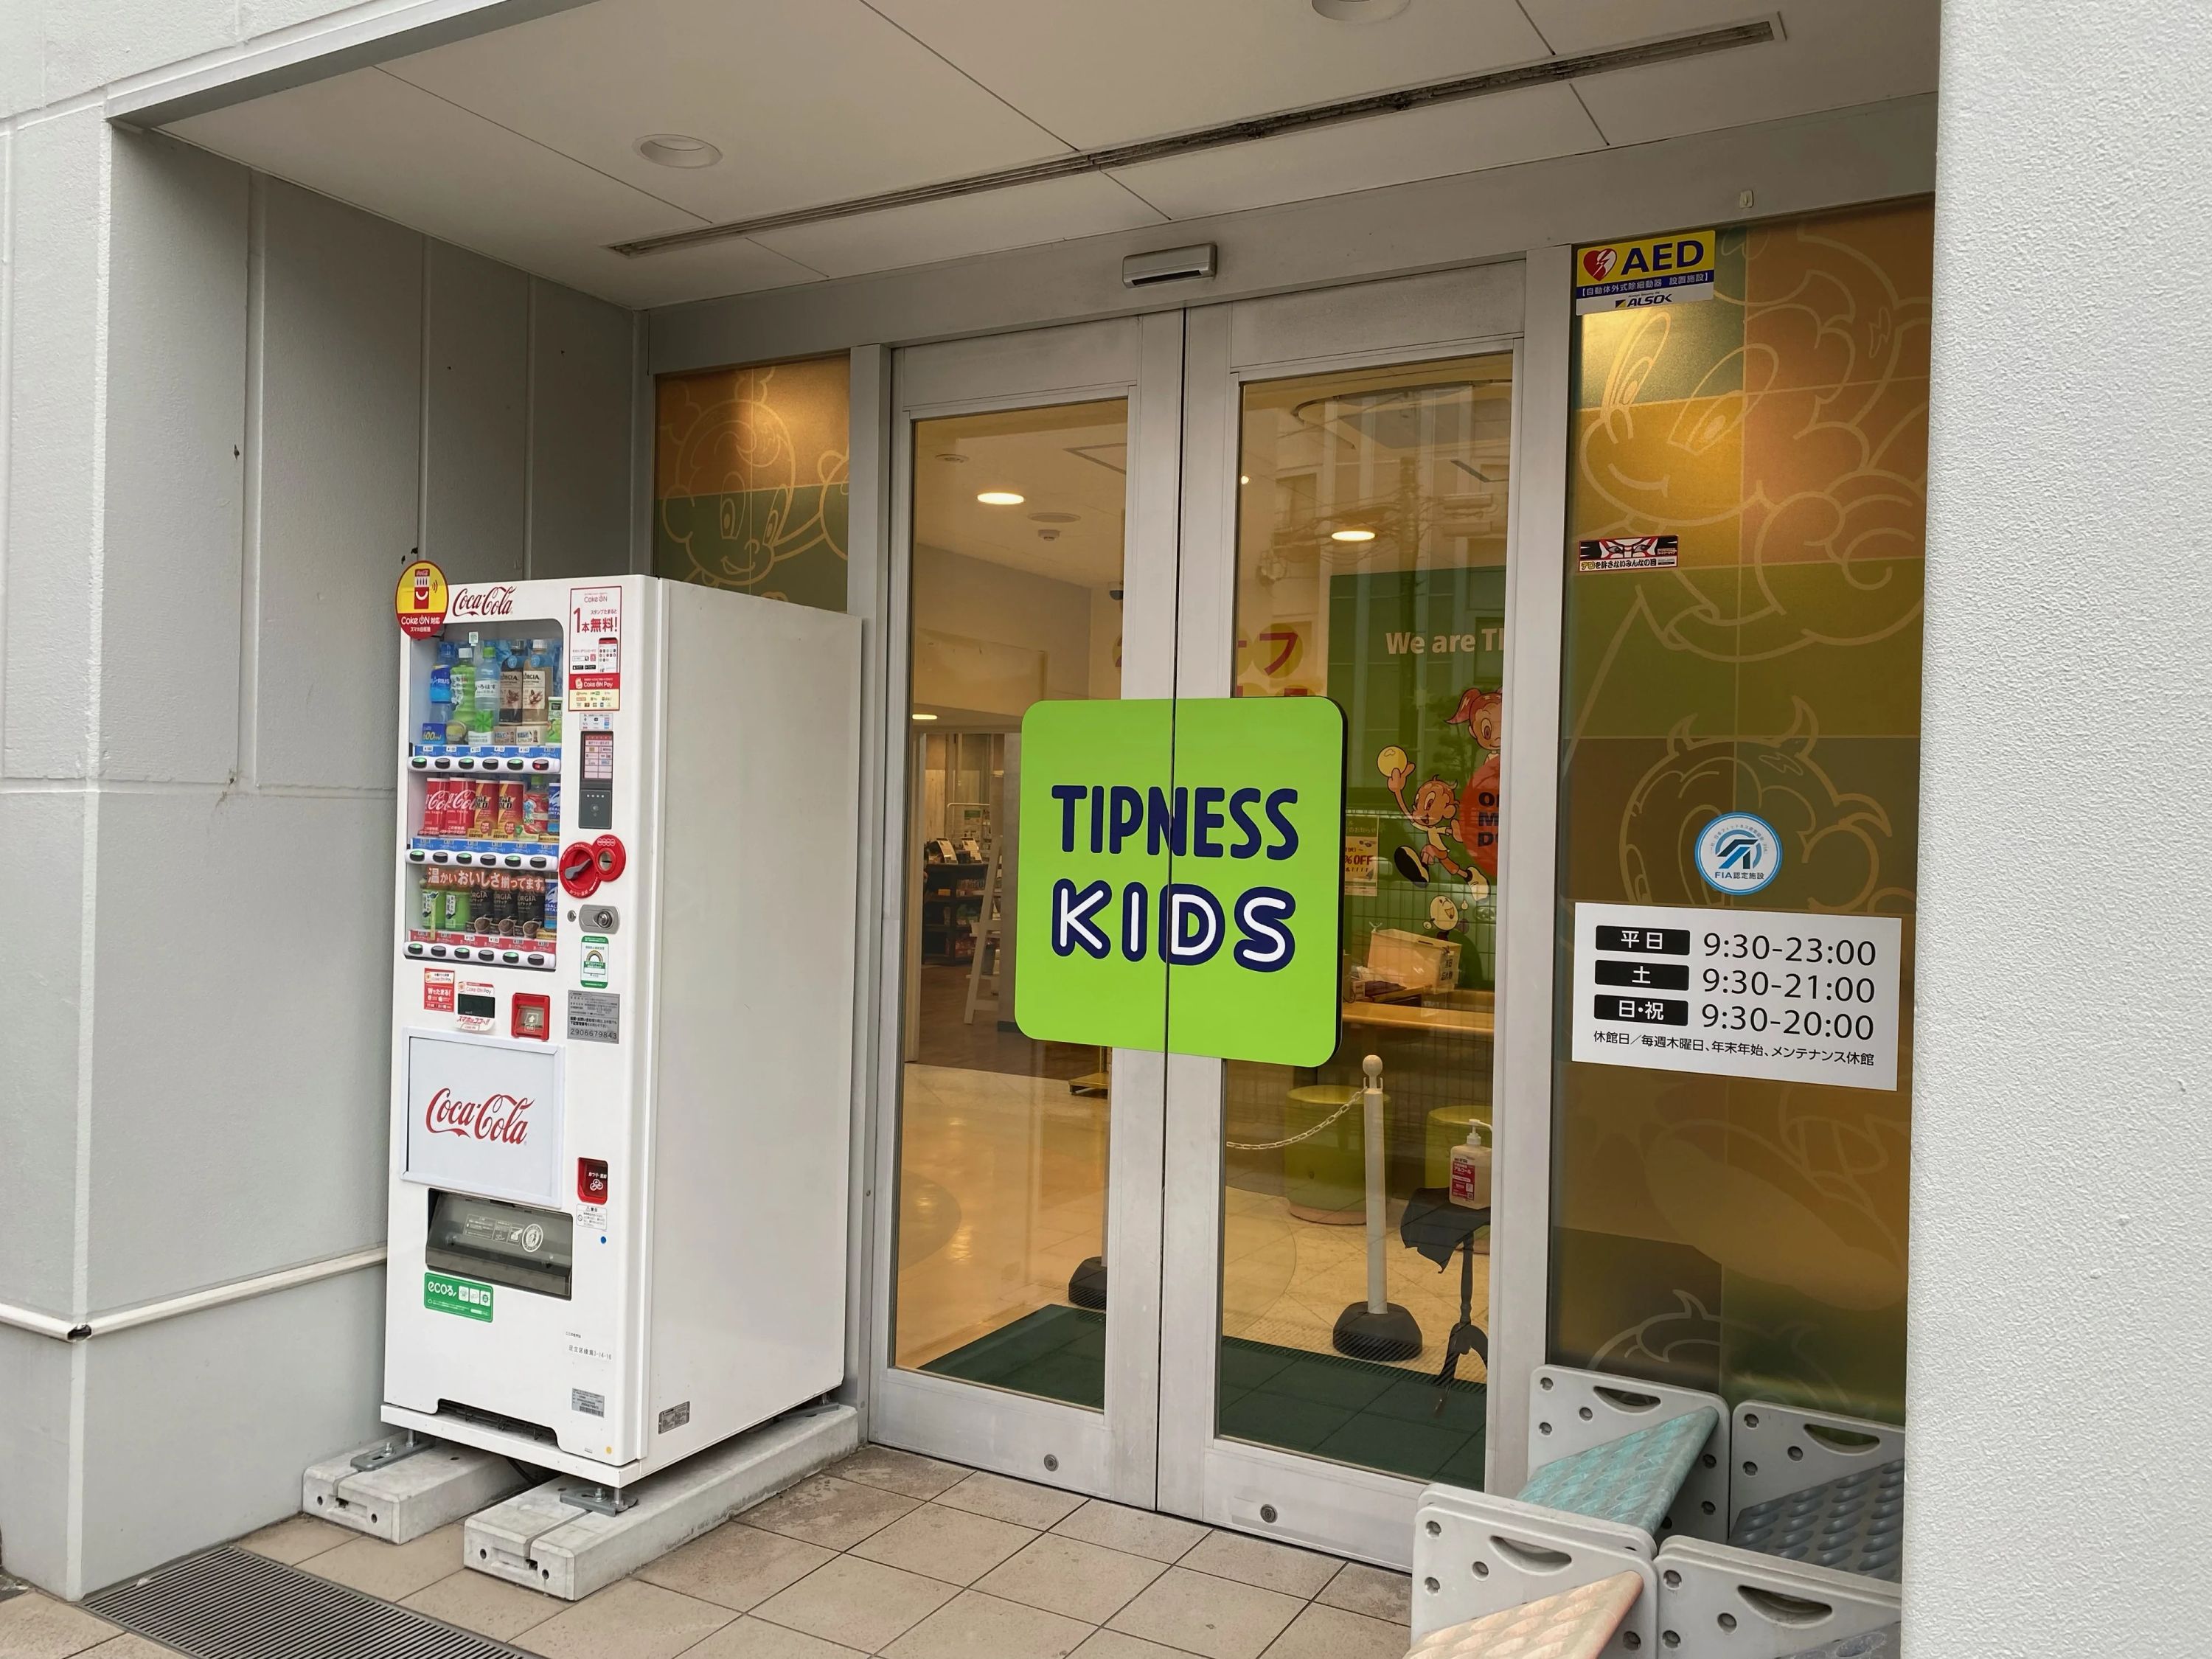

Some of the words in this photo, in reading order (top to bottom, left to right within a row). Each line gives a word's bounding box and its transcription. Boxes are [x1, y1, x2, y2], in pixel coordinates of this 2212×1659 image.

[1621, 240, 1705, 276] AED
[1627, 294, 1672, 307] ALSOK
[452, 586, 518, 616] Coca-Cola
[1386, 631, 1425, 655] We
[1432, 633, 1476, 654] are
[1051, 786, 1298, 860] TIPNESS
[428, 867, 545, 891] 温かいおいしさ揃ってます。
[1051, 879, 1297, 972] KIDS
[1621, 930, 1664, 950] 平日
[1703, 932, 1877, 967] 9:30-23:00
[1632, 966, 1651, 985] 土
[1703, 967, 1876, 1004] 9:30-21:00
[1618, 1000, 1664, 1021] 日・祝
[1702, 1004, 1874, 1041] 9:30-20:00
[425, 1088, 535, 1144] Coca-Cola
